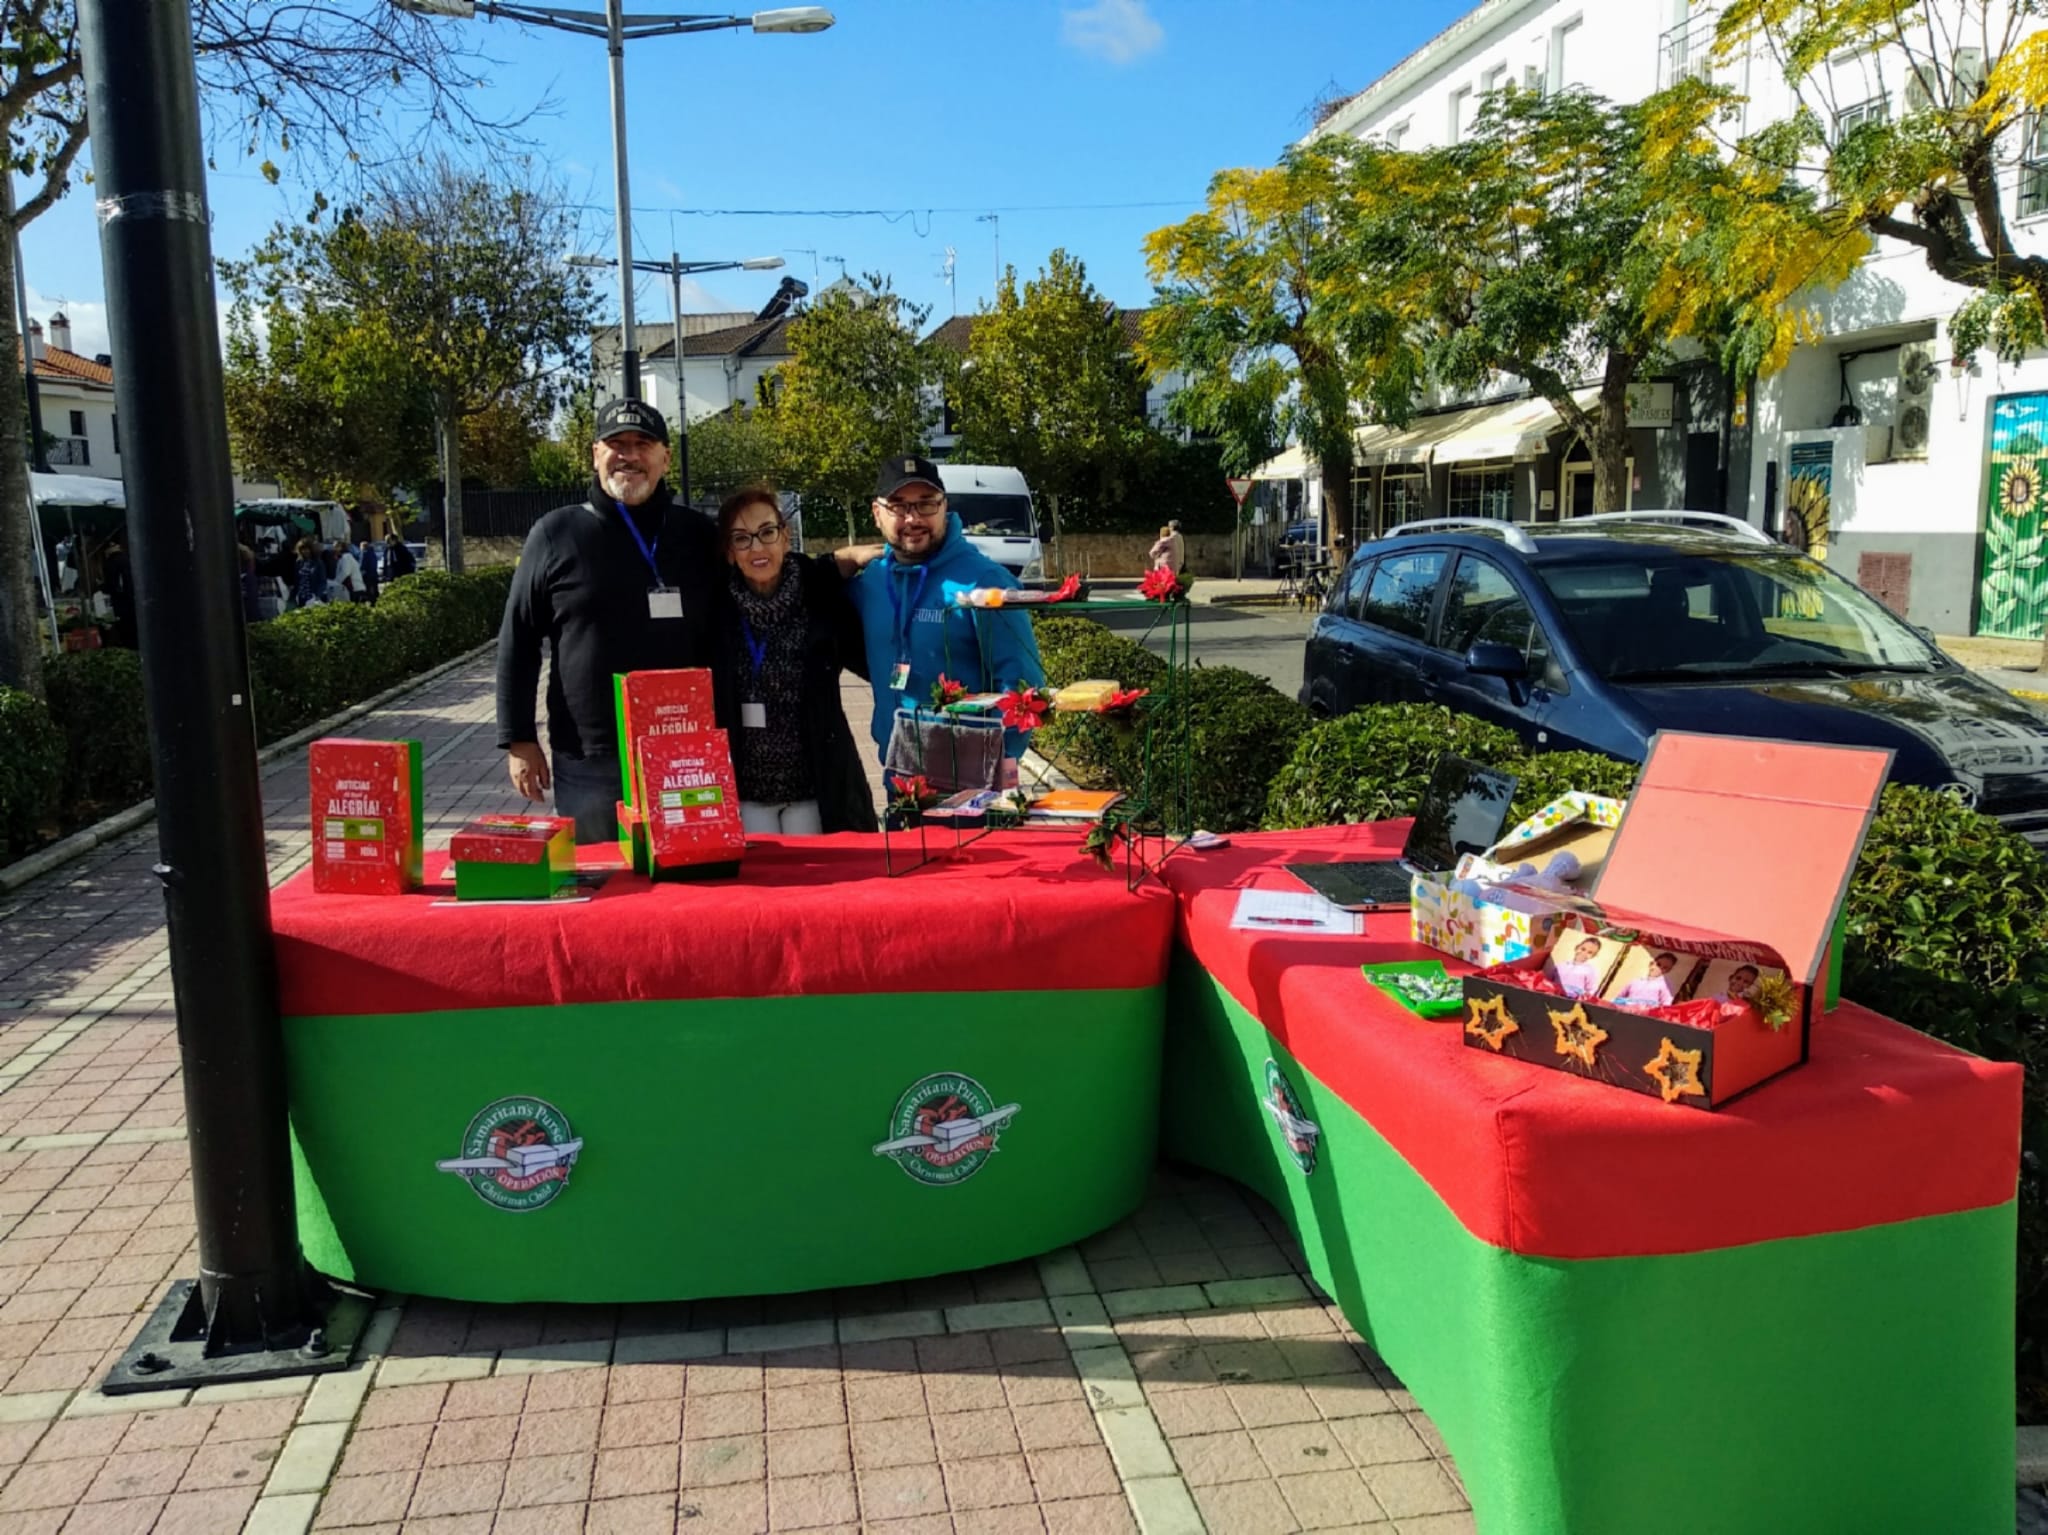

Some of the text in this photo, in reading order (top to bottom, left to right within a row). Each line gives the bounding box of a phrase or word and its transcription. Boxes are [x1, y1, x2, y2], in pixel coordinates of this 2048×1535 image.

[663, 768, 717, 789] ALEGRÍA!
[327, 793, 380, 816] ALEGRÍA!
[895, 1080, 984, 1136] Samaritan's Purse
[466, 1103, 564, 1157] Samaritan's Purse
[925, 1137, 985, 1166] OPERATION
[498, 1167, 560, 1190] OPERATION
[481, 1181, 553, 1206] Christmas Child
